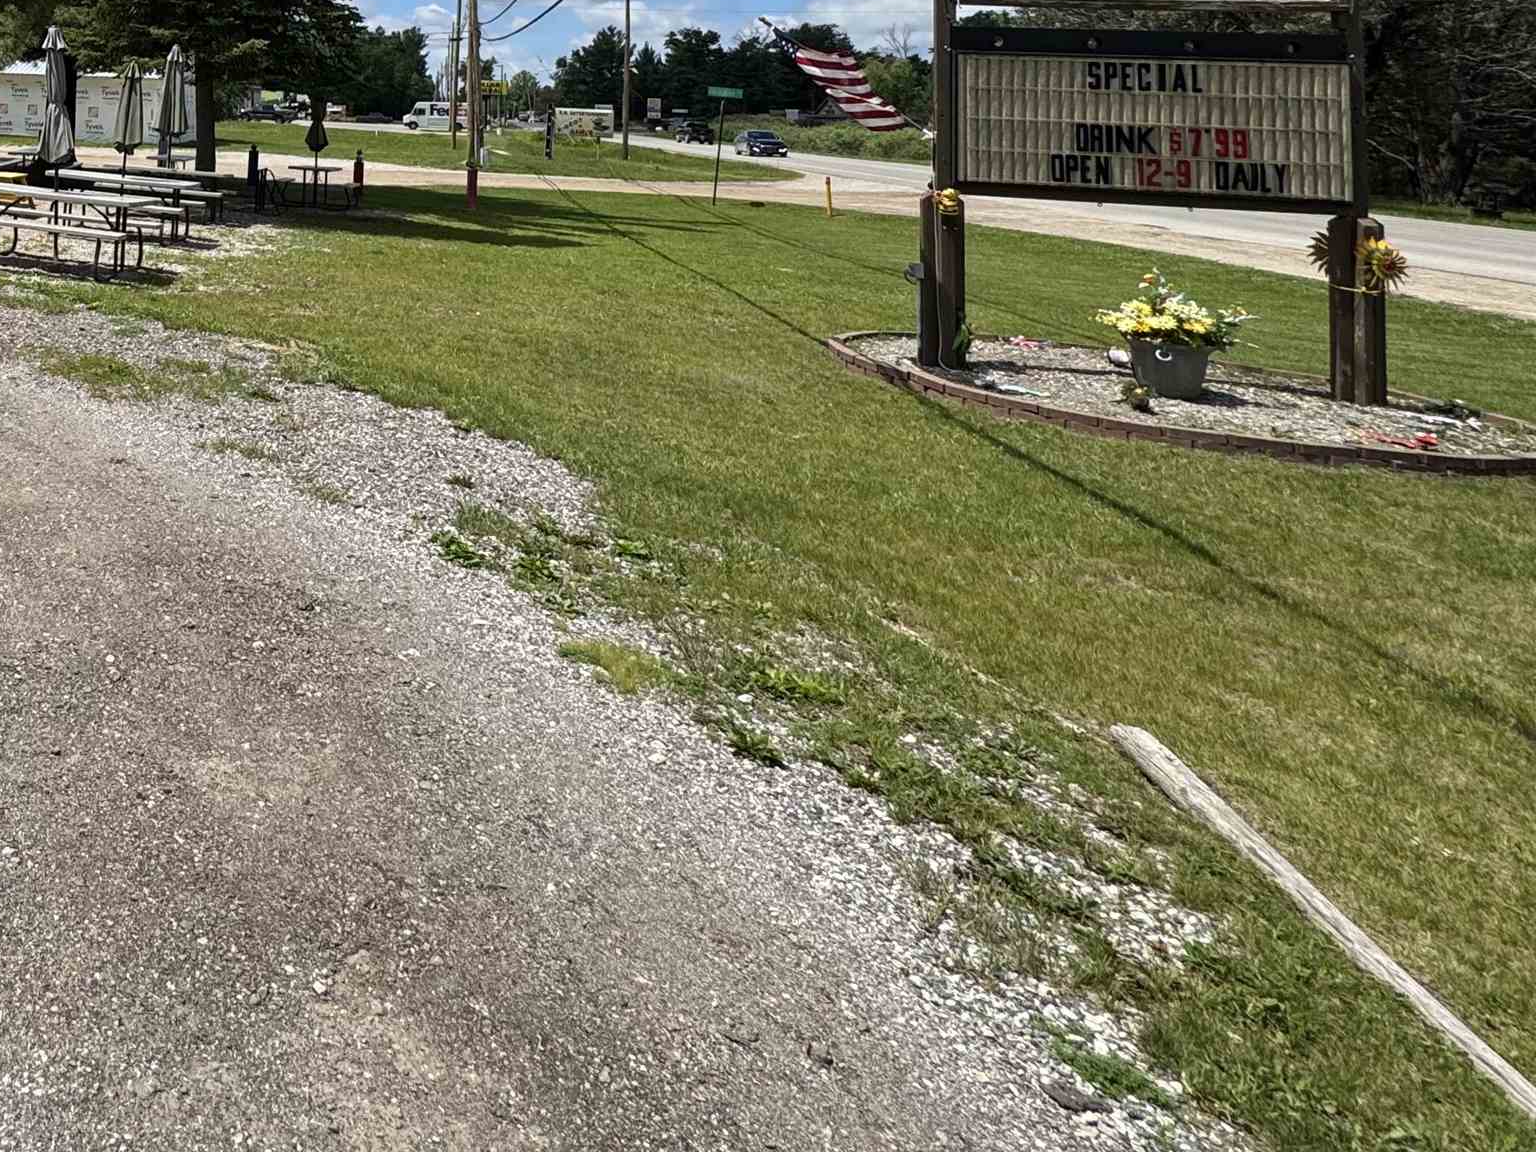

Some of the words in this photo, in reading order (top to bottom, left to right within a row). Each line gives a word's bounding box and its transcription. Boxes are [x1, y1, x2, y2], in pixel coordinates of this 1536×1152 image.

[1087, 61, 1203, 93] SPECIAL
[1075, 123, 1157, 155] DRINK
[1050, 153, 1111, 185] OPEN
[1136, 158, 1192, 189] 12-9
[1214, 161, 1287, 194] DAILY
